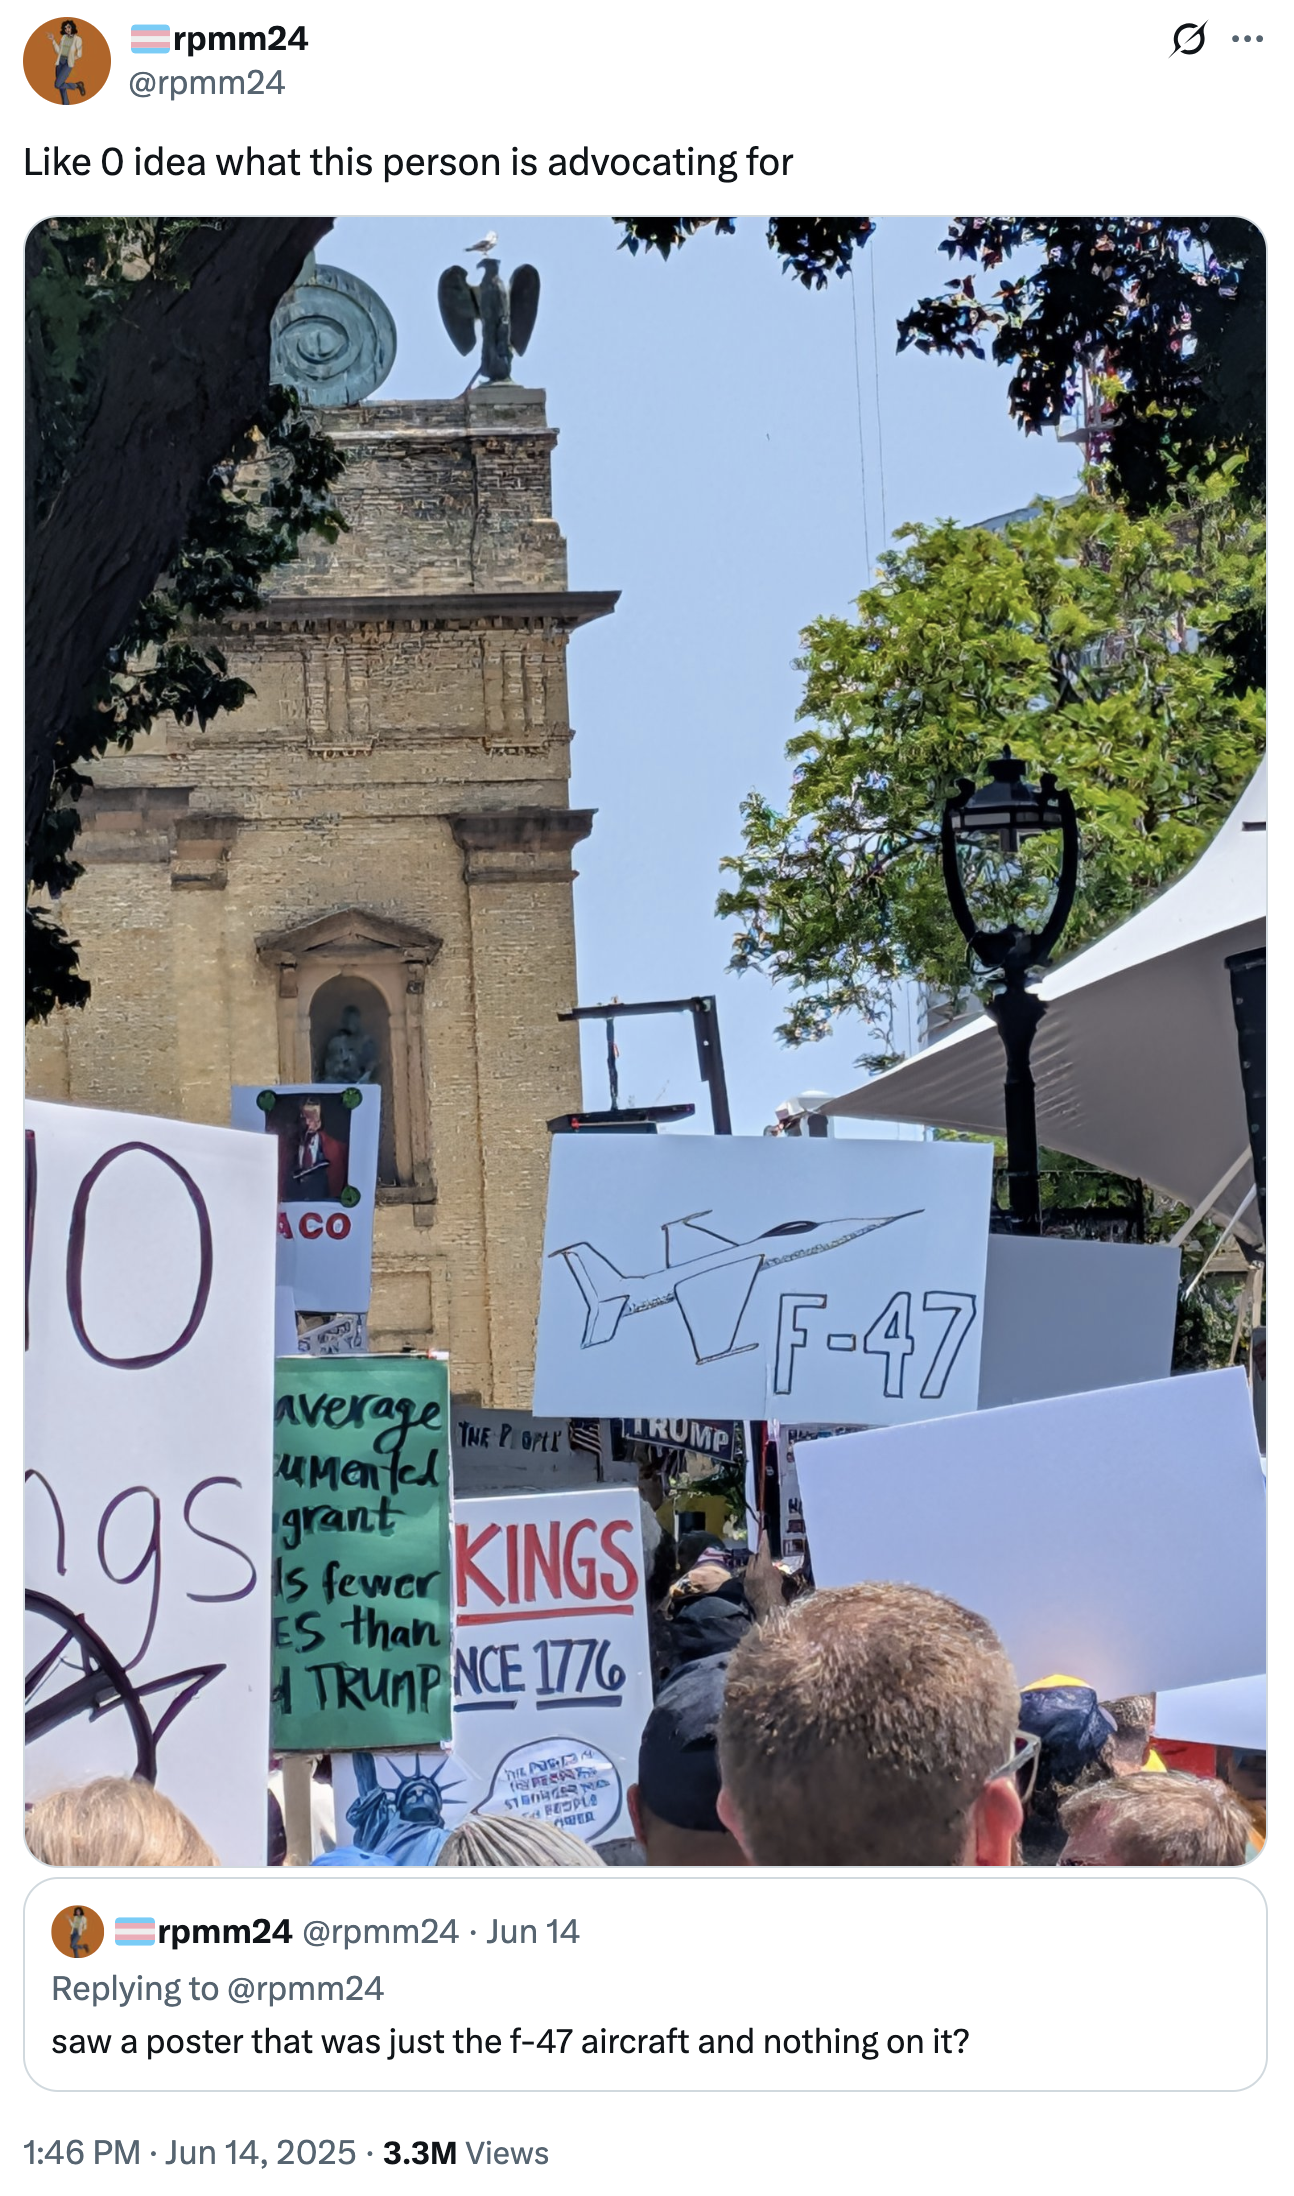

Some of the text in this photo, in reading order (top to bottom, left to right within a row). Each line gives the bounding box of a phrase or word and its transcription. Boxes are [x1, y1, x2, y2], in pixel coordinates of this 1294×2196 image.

[25, 1130, 213, 1370] O
[773, 1290, 977, 1399] F-47
[322, 1560, 442, 1606] fewer
[455, 1518, 639, 1607] KINGS
[340, 1604, 442, 1652] than
[532, 1637, 627, 1696] 1776
